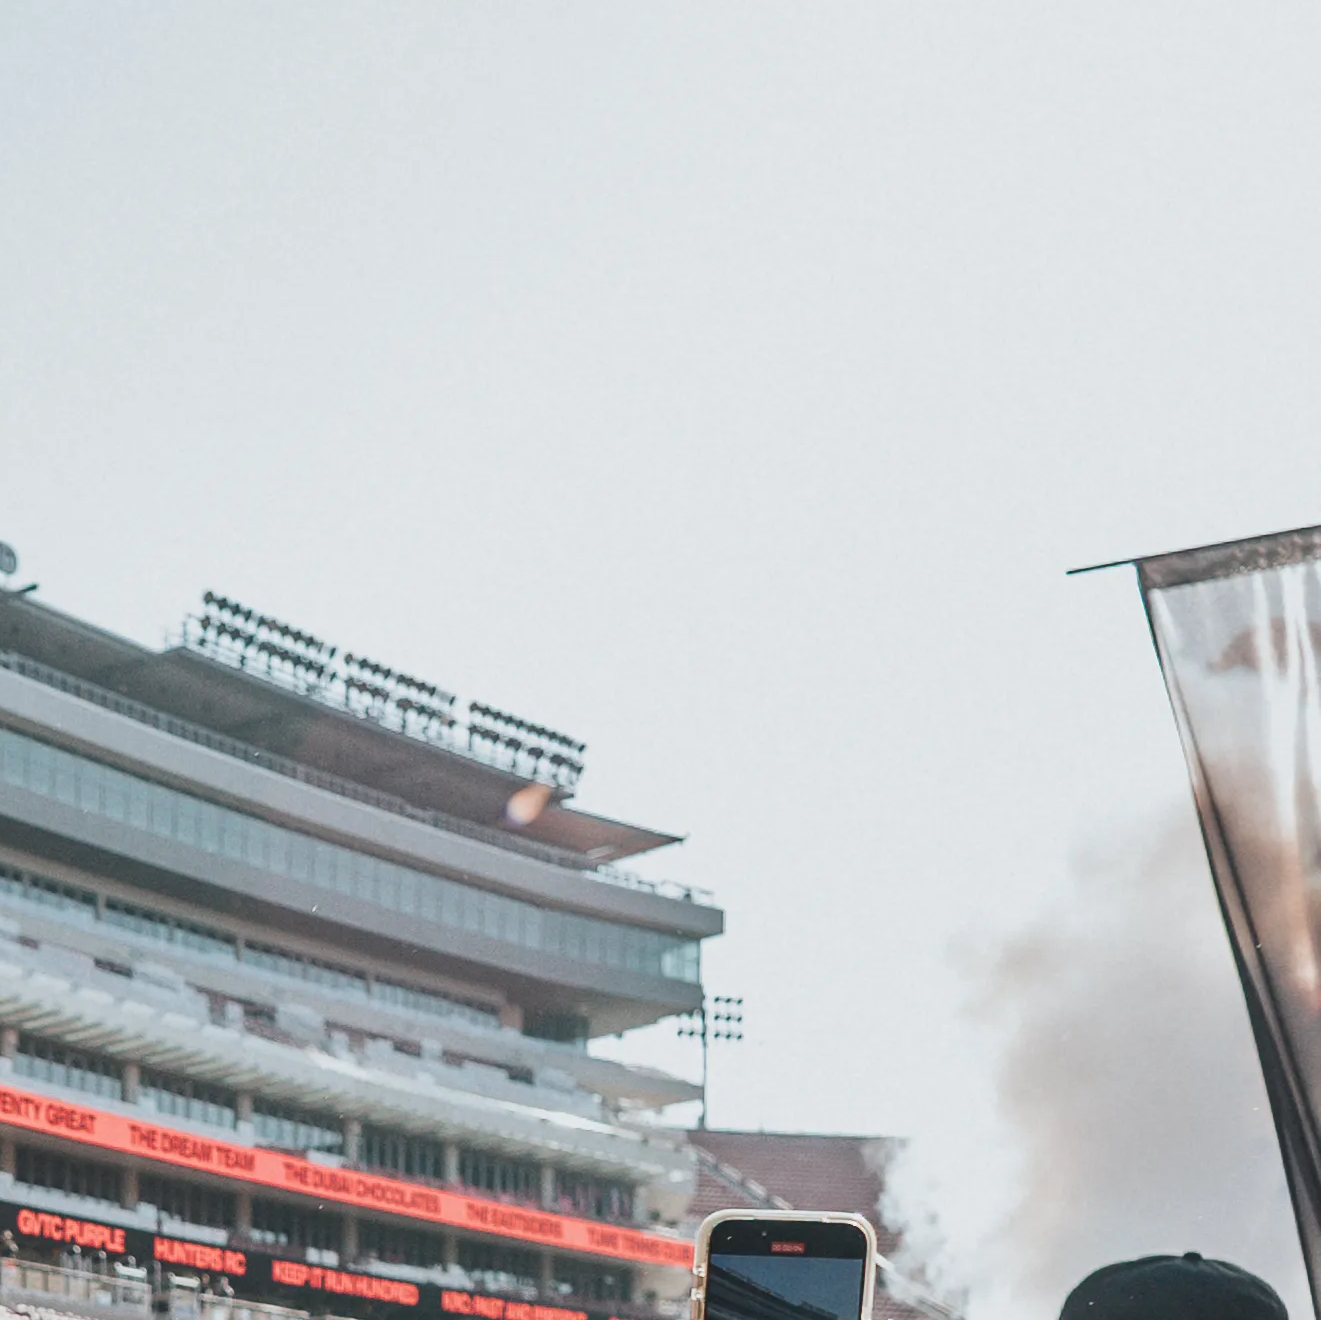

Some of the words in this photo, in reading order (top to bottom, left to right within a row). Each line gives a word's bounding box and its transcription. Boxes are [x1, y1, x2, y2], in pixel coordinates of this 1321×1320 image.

[46, 1104, 97, 1134] GREAT
[129, 1124, 158, 1150] THE
[161, 1132, 213, 1163] DREAM
[216, 1145, 256, 1172] TEAM
[282, 1161, 308, 1185] THE
[64, 1217, 126, 1254] PURPLE
[153, 1236, 222, 1273] HUNTERS
[223, 1249, 247, 1277] RC
[271, 1259, 308, 1287] KEEP
[309, 1266, 324, 1289] IT
[324, 1269, 353, 1296] RUN
